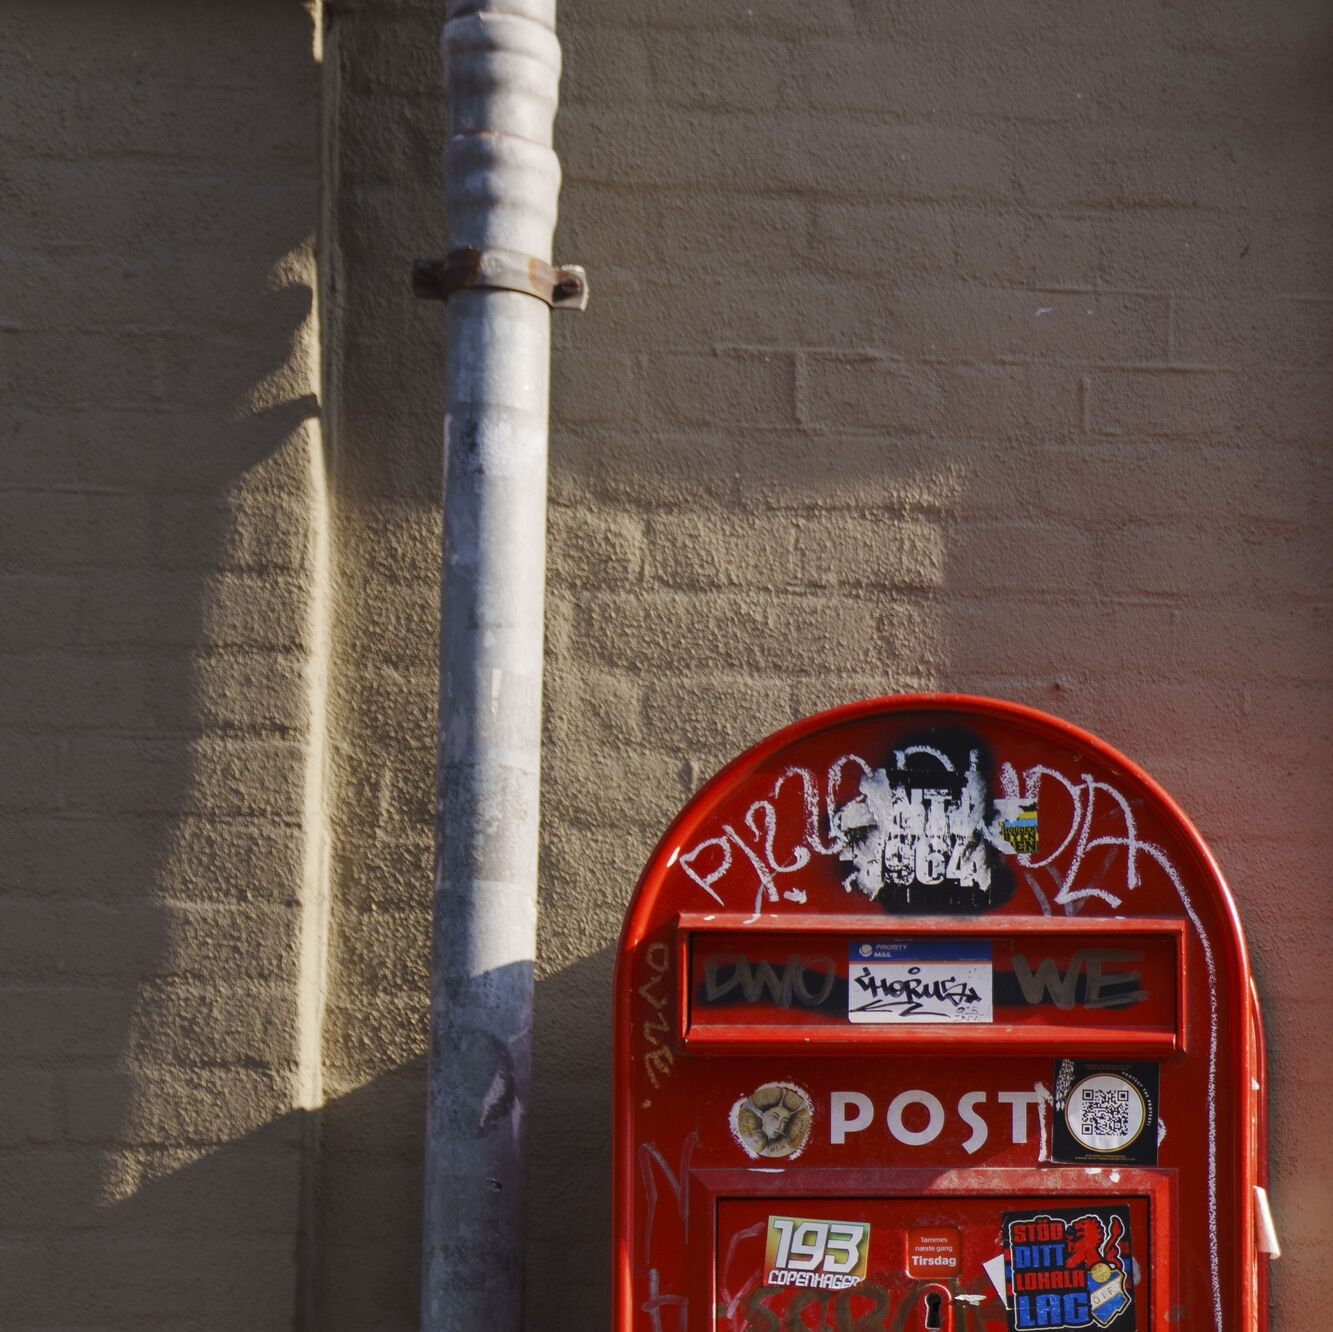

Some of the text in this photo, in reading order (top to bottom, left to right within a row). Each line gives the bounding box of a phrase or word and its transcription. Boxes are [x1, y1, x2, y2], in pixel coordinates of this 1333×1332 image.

[830, 1089, 1041, 1155] POST
[1013, 1218, 1064, 1244] STÖD
[773, 1219, 865, 1274] 193
[1014, 1243, 1066, 1269] DITT
[911, 1255, 957, 1268] Tirsdag
[1016, 1269, 1086, 1292] LOKALA
[1018, 1292, 1090, 1327] LAG
